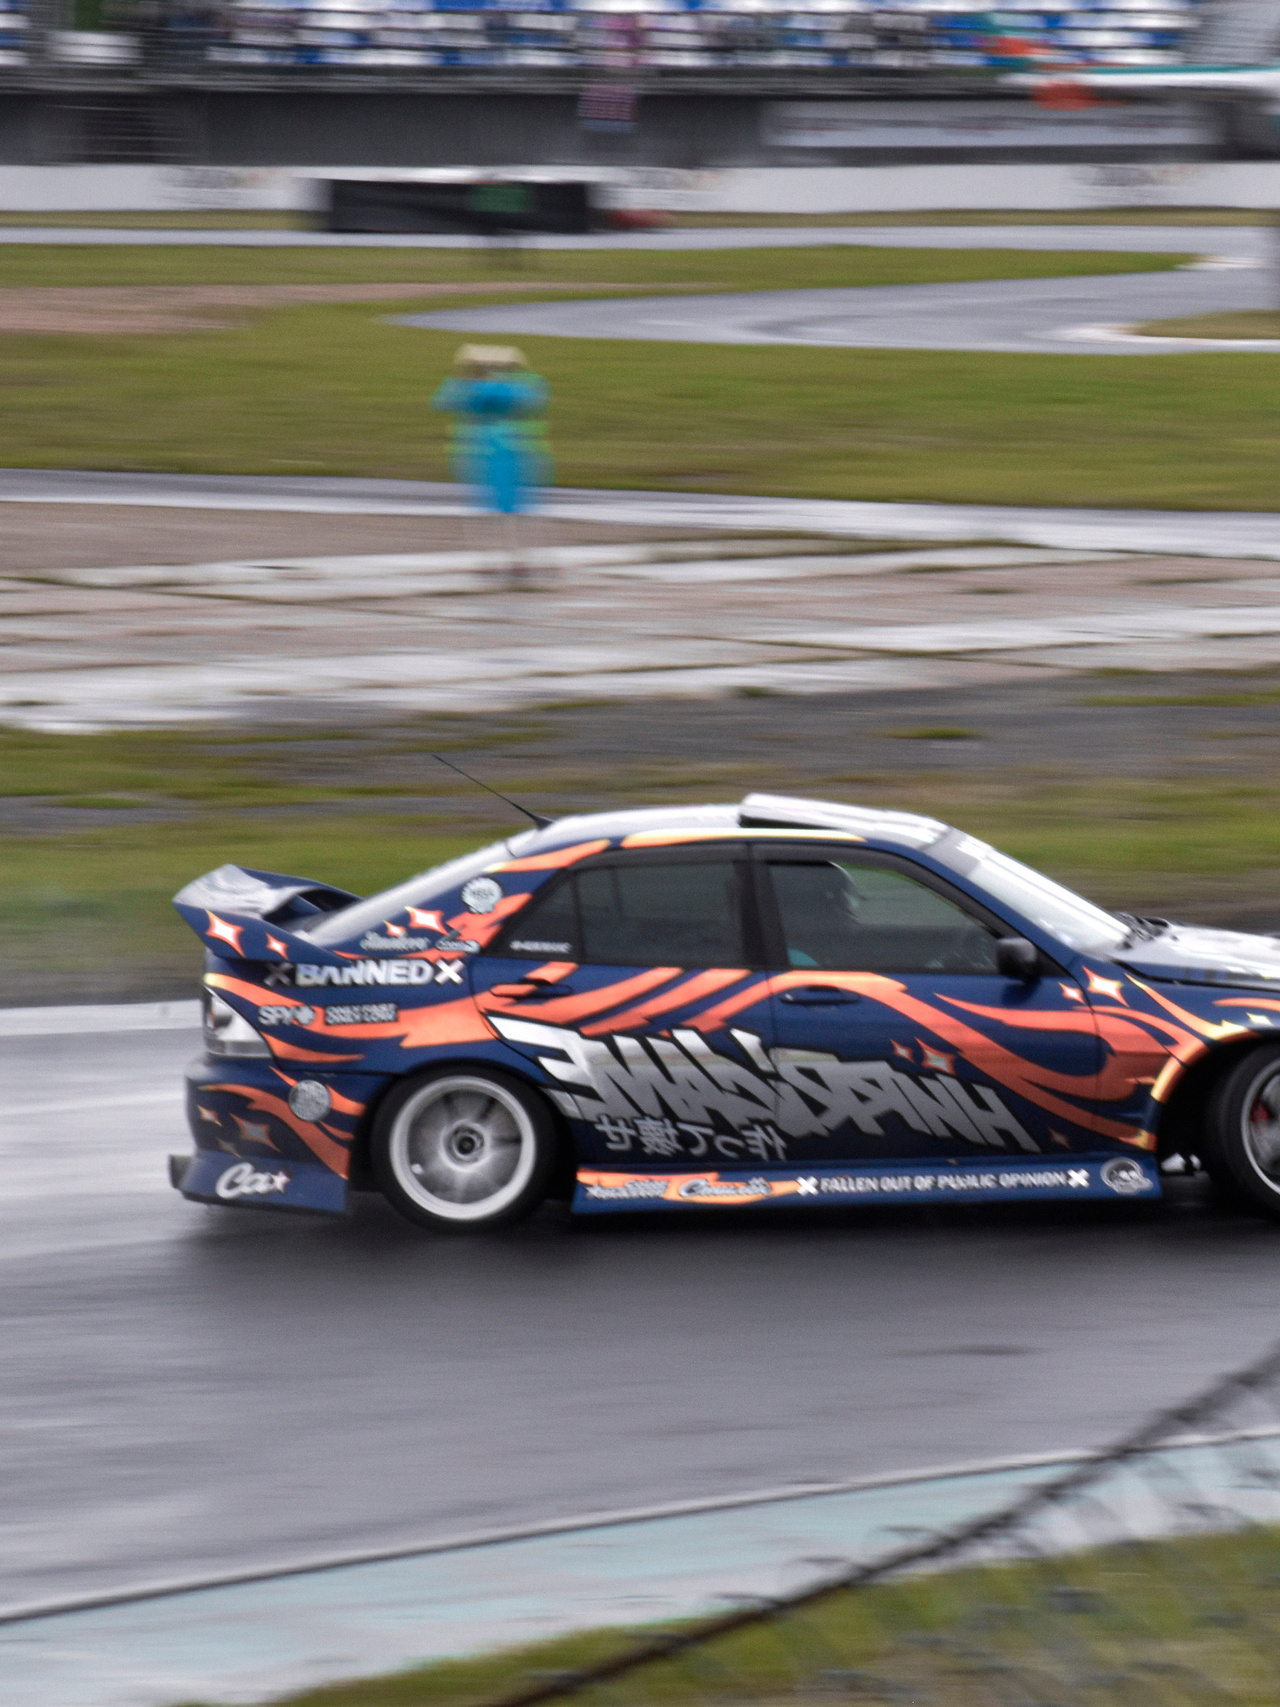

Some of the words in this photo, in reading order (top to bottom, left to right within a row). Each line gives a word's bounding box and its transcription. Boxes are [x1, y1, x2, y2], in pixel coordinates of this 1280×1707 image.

[296, 959, 434, 987] BANNED
[820, 1177, 876, 1193] FALLEN
[879, 1176, 911, 1192] OUT
[914, 1175, 936, 1191] OF
[999, 1171, 1066, 1188] OPINION
